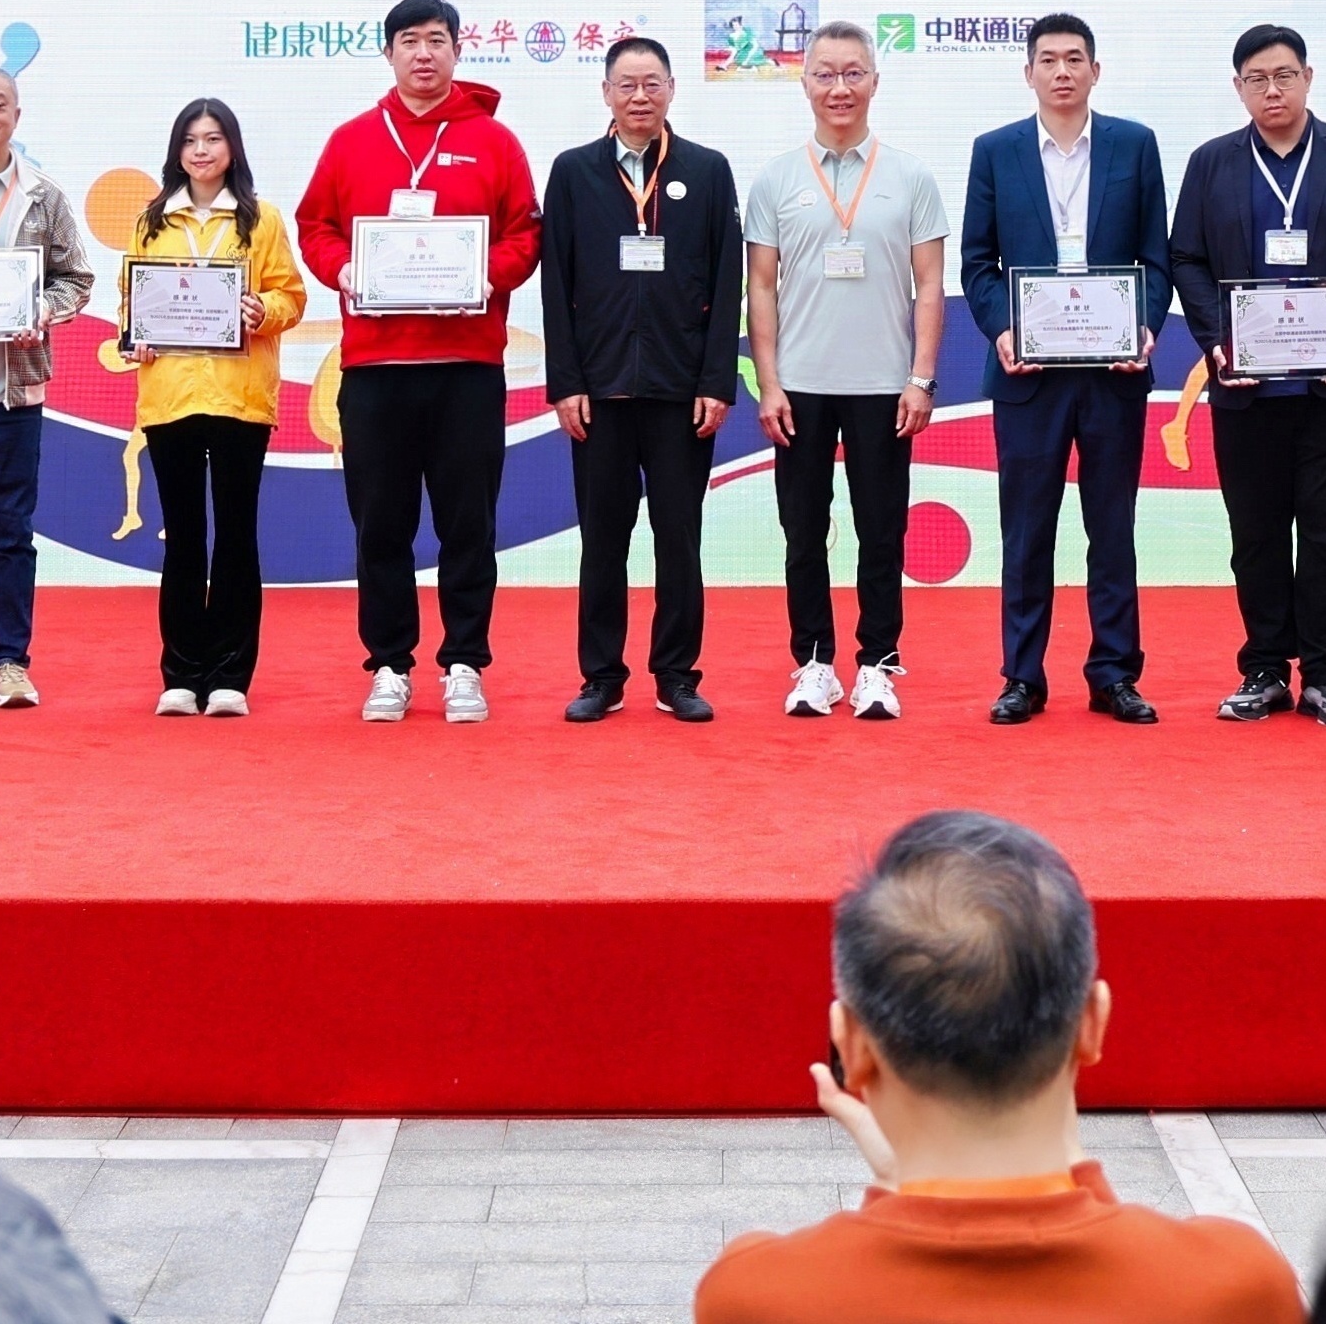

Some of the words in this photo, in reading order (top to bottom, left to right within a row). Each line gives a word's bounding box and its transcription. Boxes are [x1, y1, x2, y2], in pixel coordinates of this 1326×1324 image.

[925, 45, 994, 53] ZHONGLIAN
[1002, 45, 1025, 53] TON
[577, 56, 606, 64] SECU
